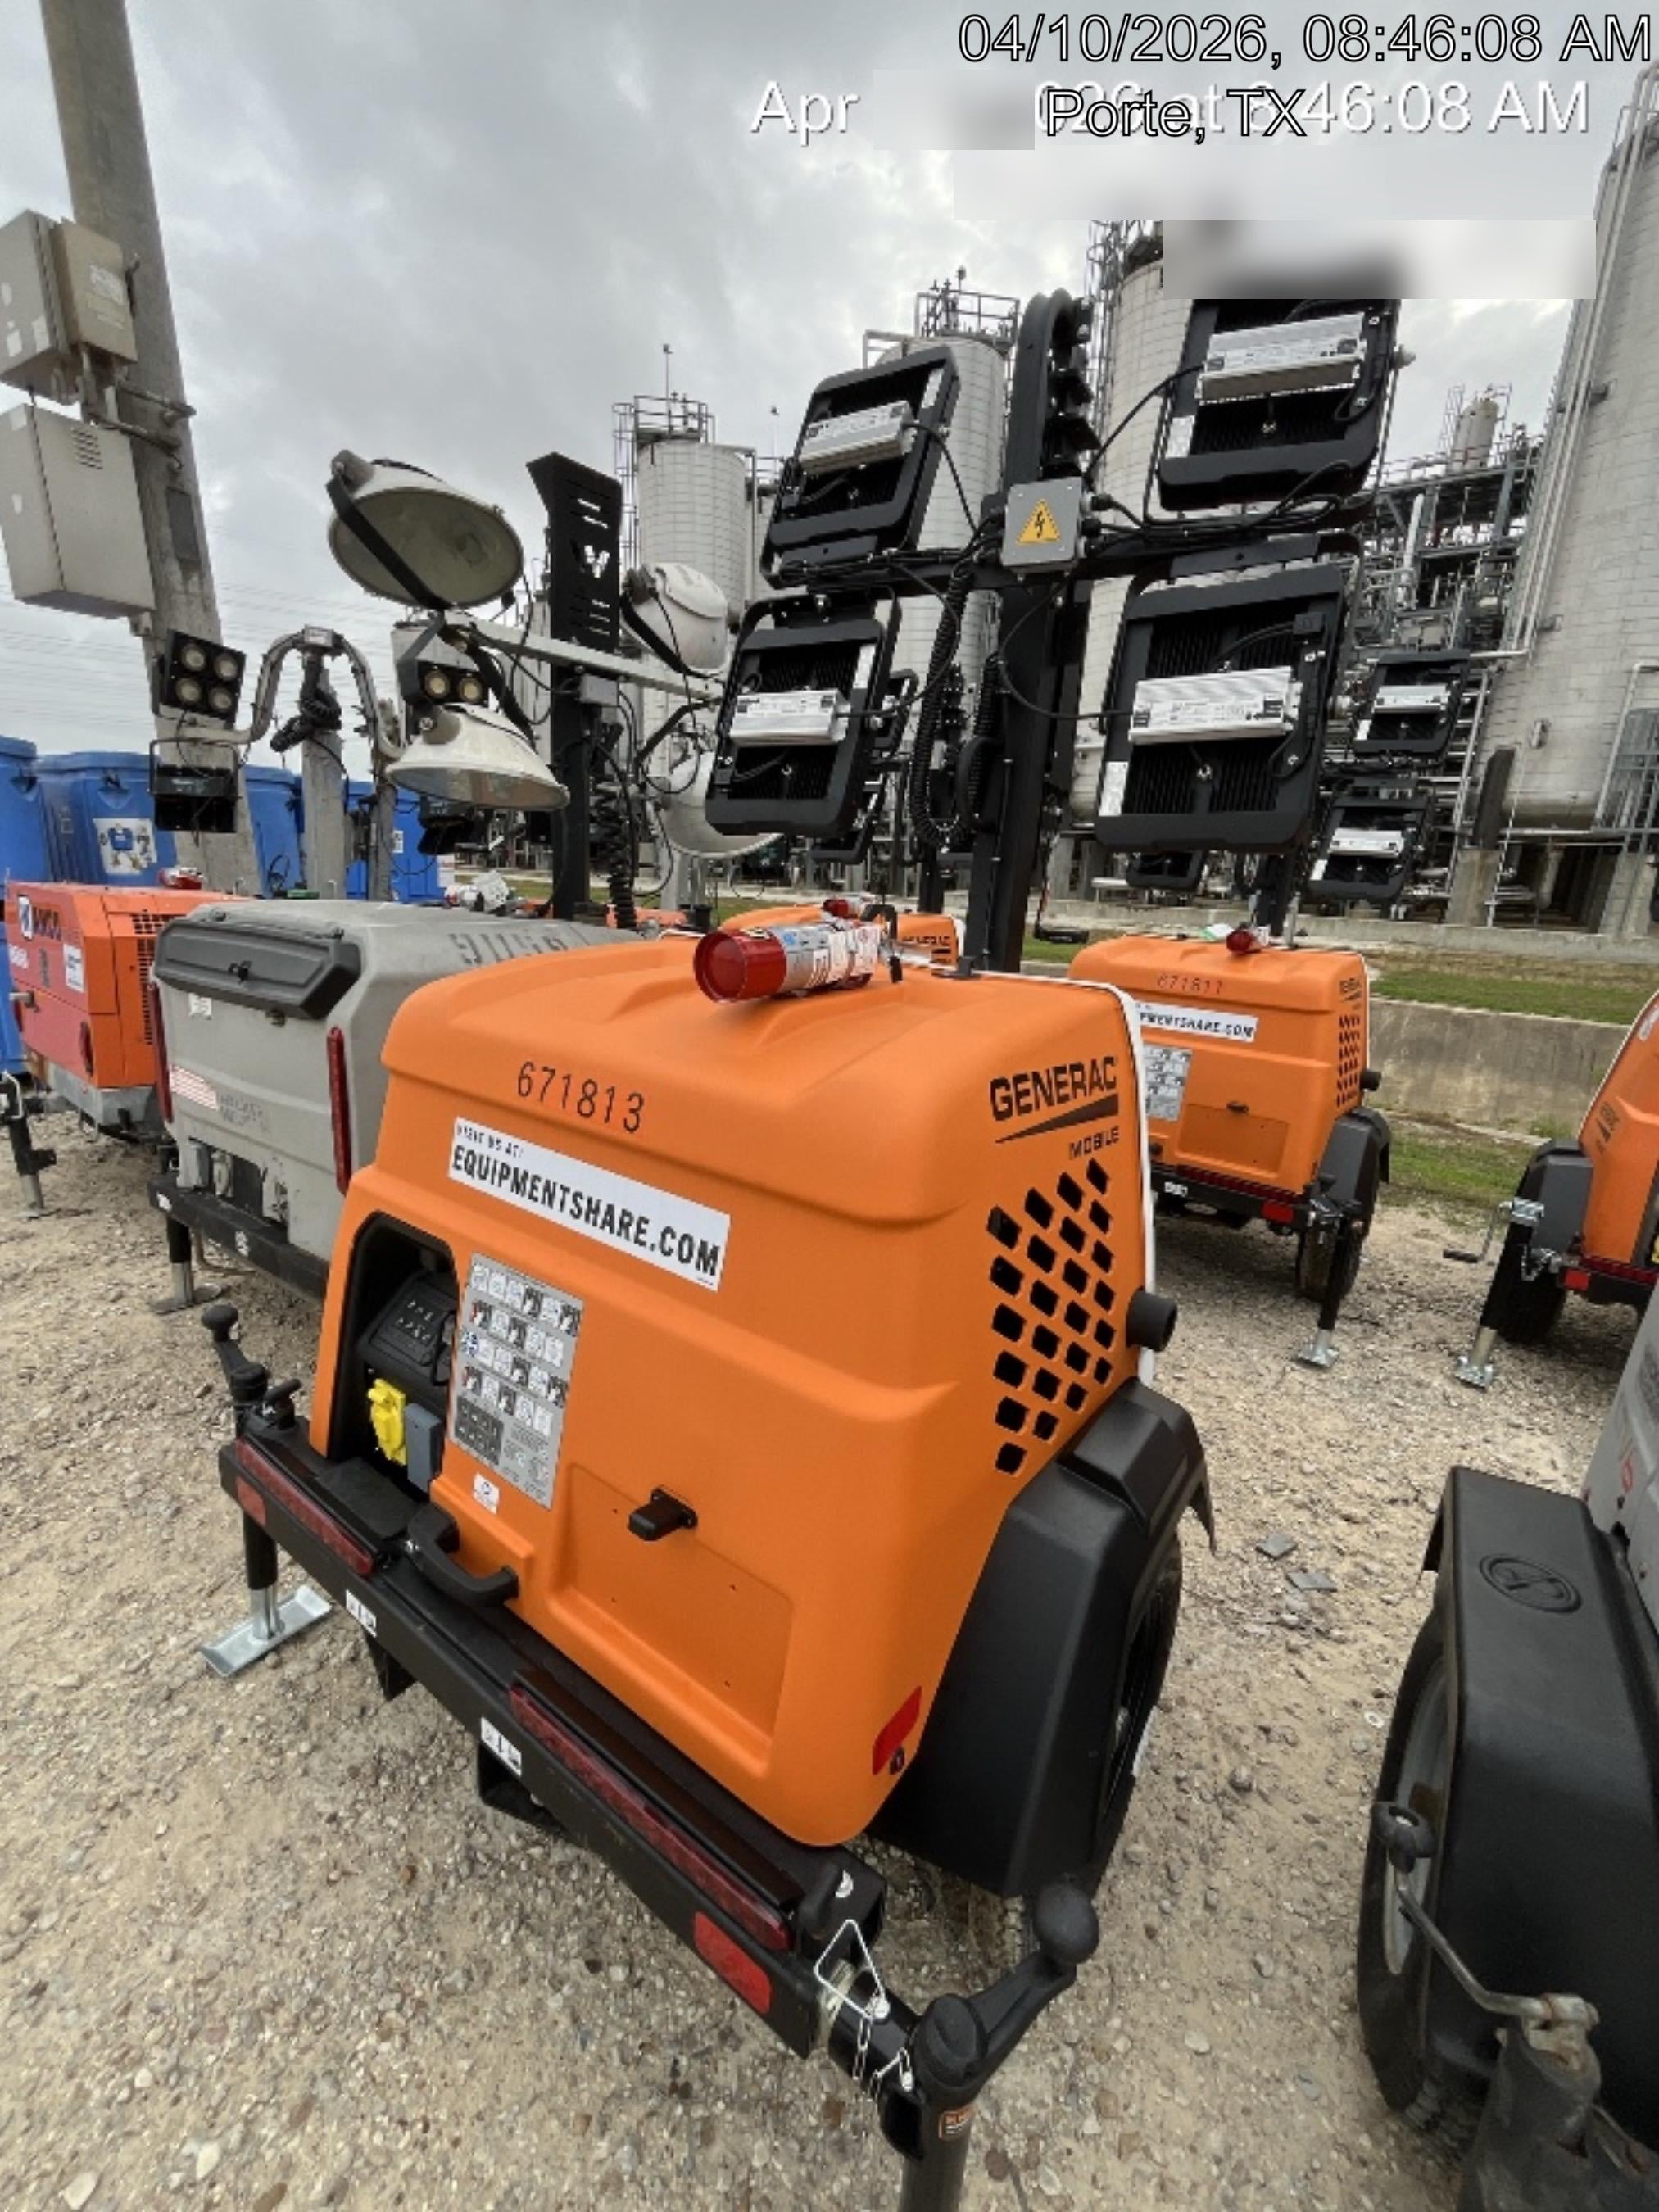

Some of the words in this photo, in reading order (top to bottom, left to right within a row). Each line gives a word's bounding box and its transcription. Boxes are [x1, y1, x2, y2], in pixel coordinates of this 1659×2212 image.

[517, 1061, 646, 1134] 671813
[989, 1055, 1117, 1122] GENERAC
[1068, 1125, 1121, 1160] MOBILE
[451, 1144, 720, 1277] EQUIPMENTSHARE.COM
